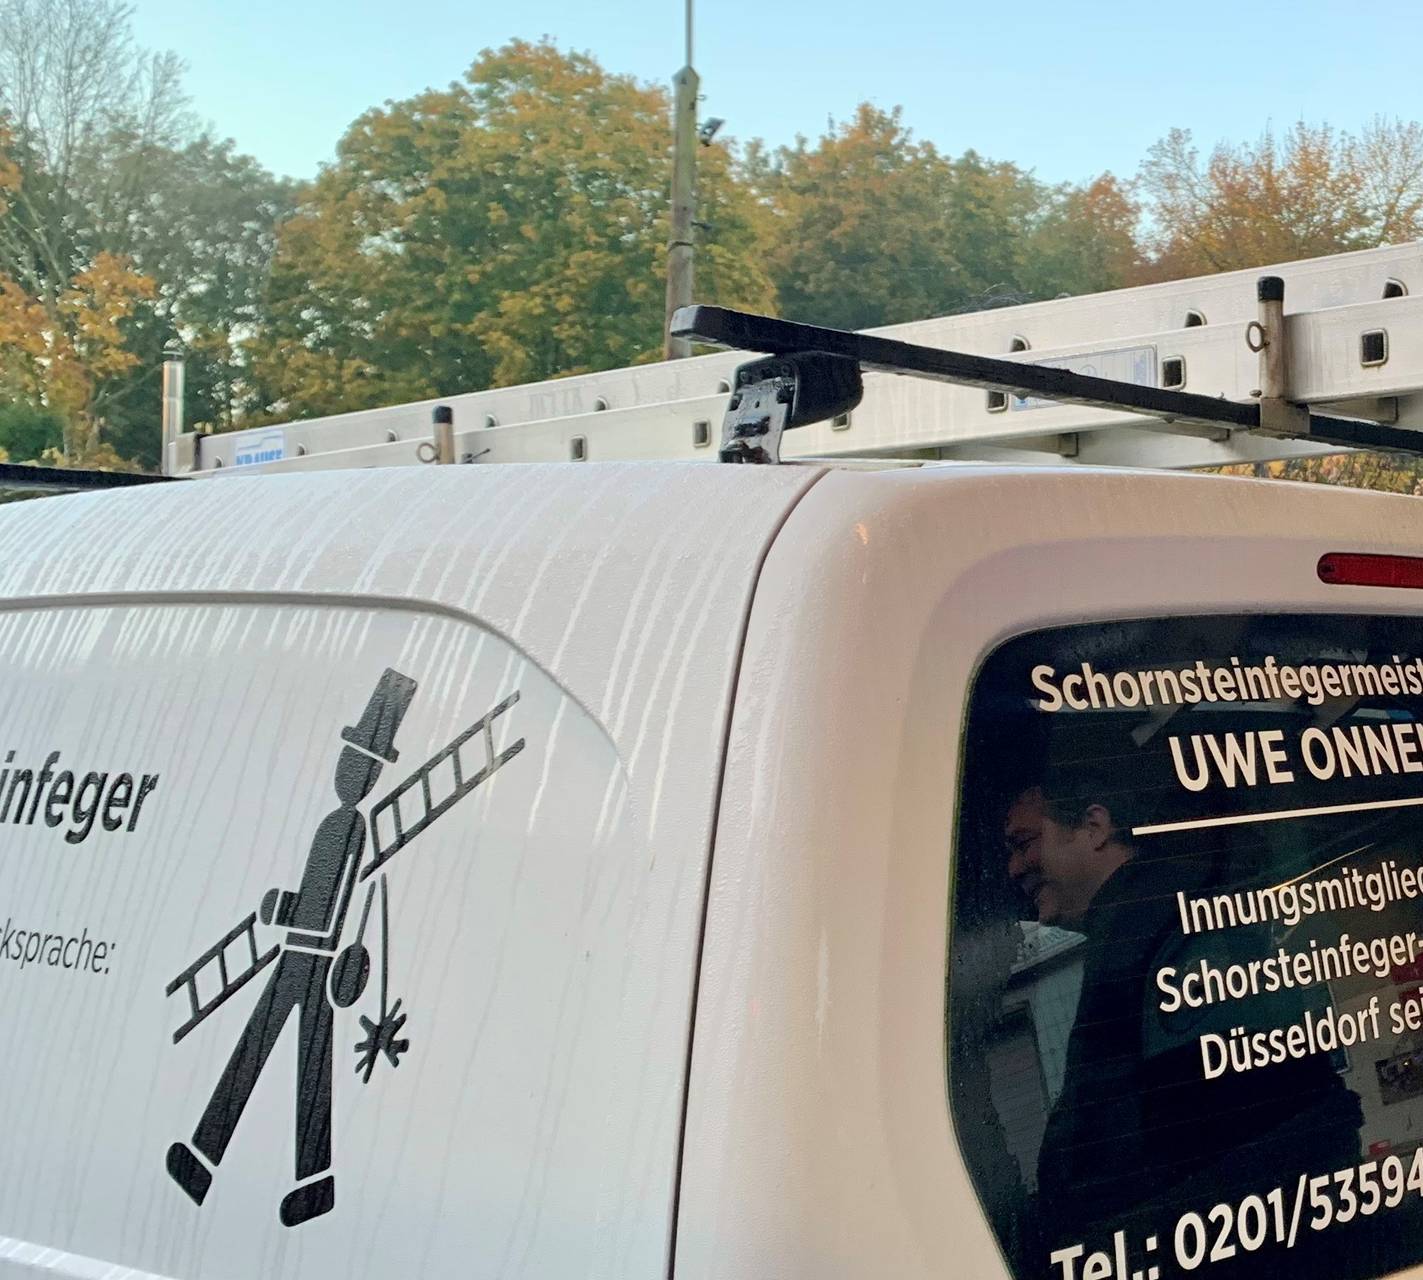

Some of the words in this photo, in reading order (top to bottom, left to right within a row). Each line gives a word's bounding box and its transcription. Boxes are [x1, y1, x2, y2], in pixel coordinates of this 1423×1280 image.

[1168, 729, 1294, 792] UWE
[0, 750, 160, 845] infeger
[0, 918, 116, 975] ksprache:
[1200, 997, 1380, 1080] Düsseldorf
[1050, 1231, 1159, 1280] Tel.:
